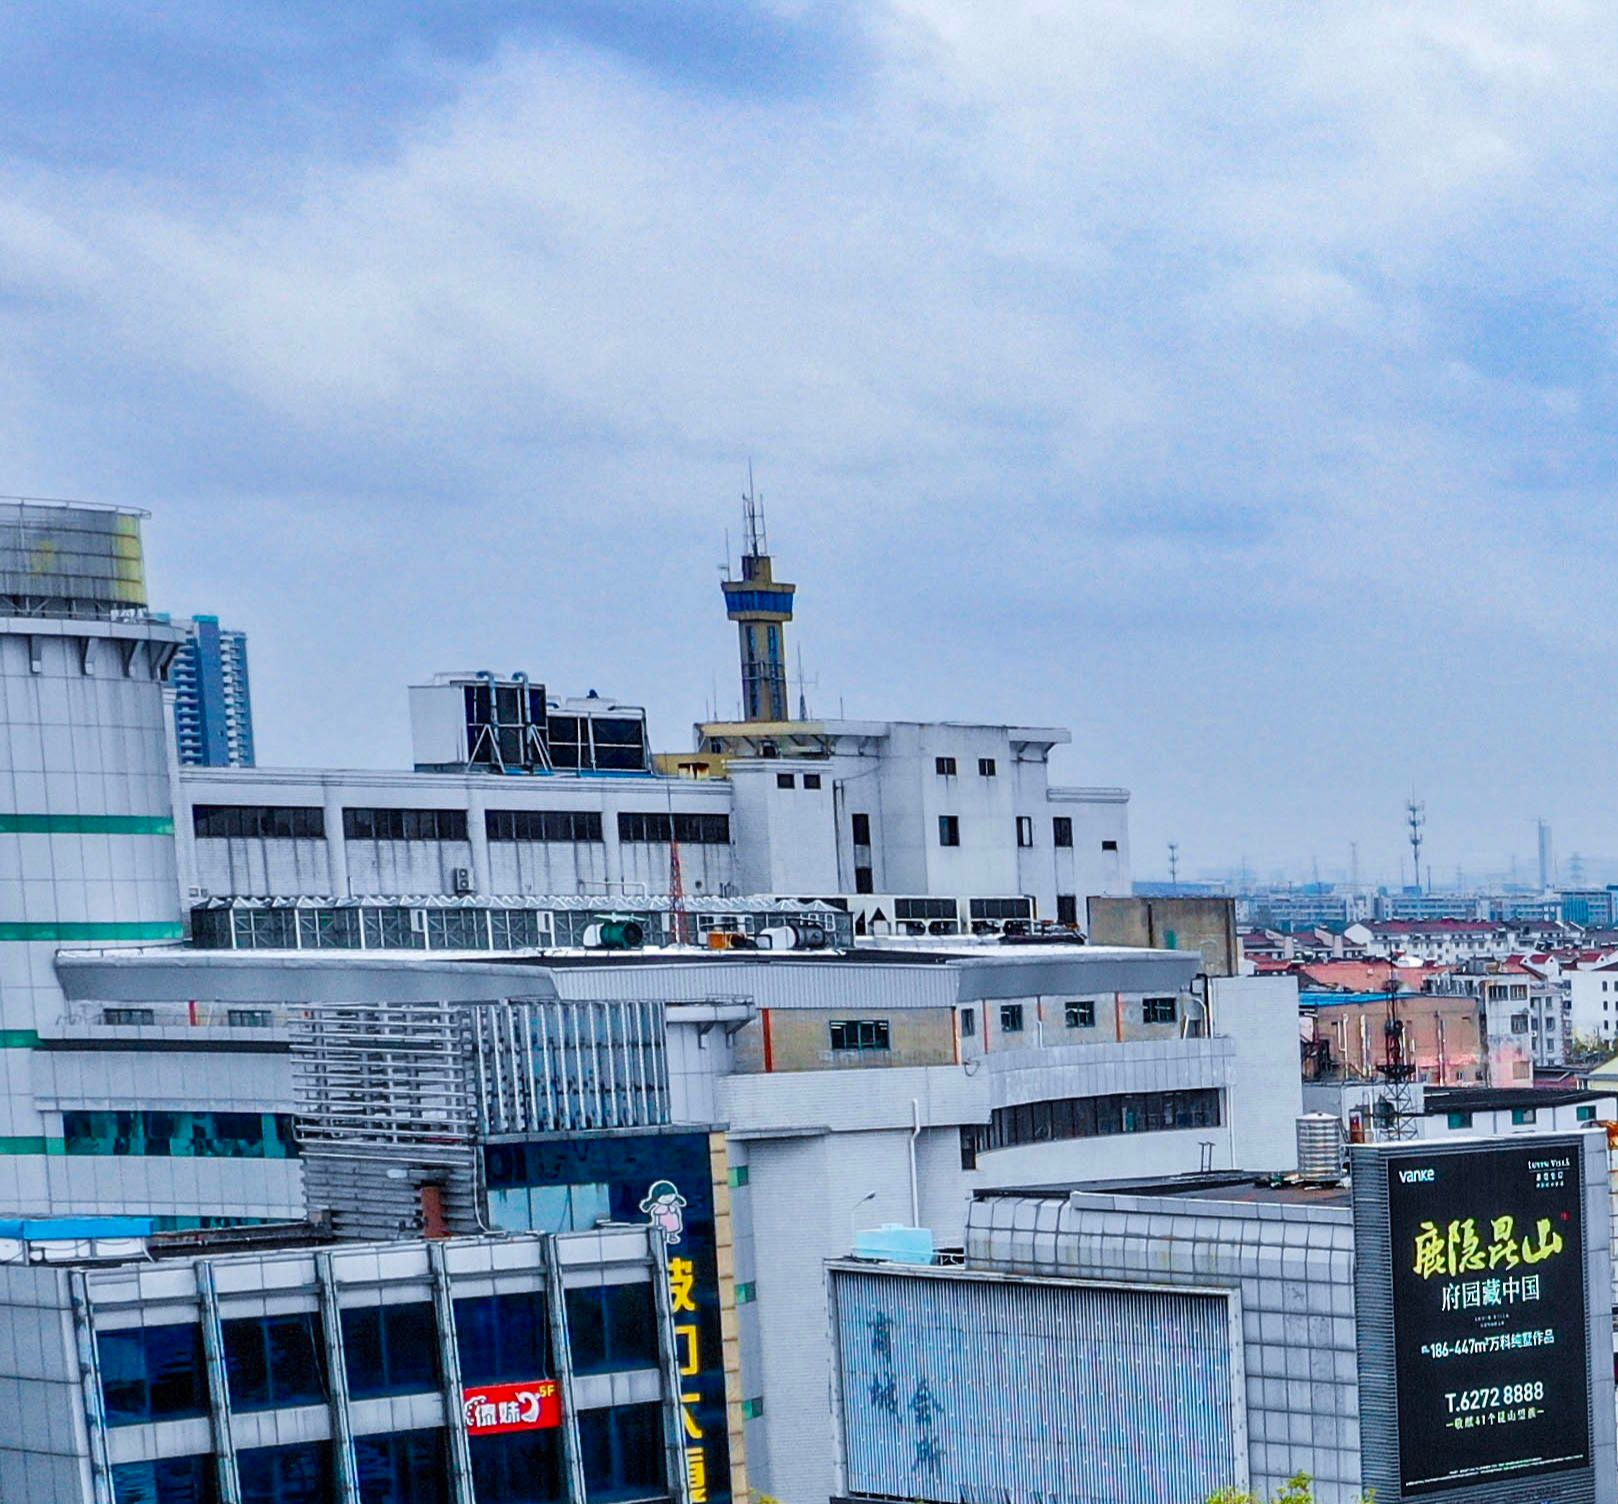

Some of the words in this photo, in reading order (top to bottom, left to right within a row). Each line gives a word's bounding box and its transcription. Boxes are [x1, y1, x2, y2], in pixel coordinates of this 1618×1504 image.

[1398, 1167, 1436, 1184] vanke
[1441, 1273, 1541, 1312] 府园藏中国
[539, 1384, 556, 1398] 5F
[1444, 1387, 1500, 1414] T.6272
[1502, 1380, 1545, 1405] 8888
